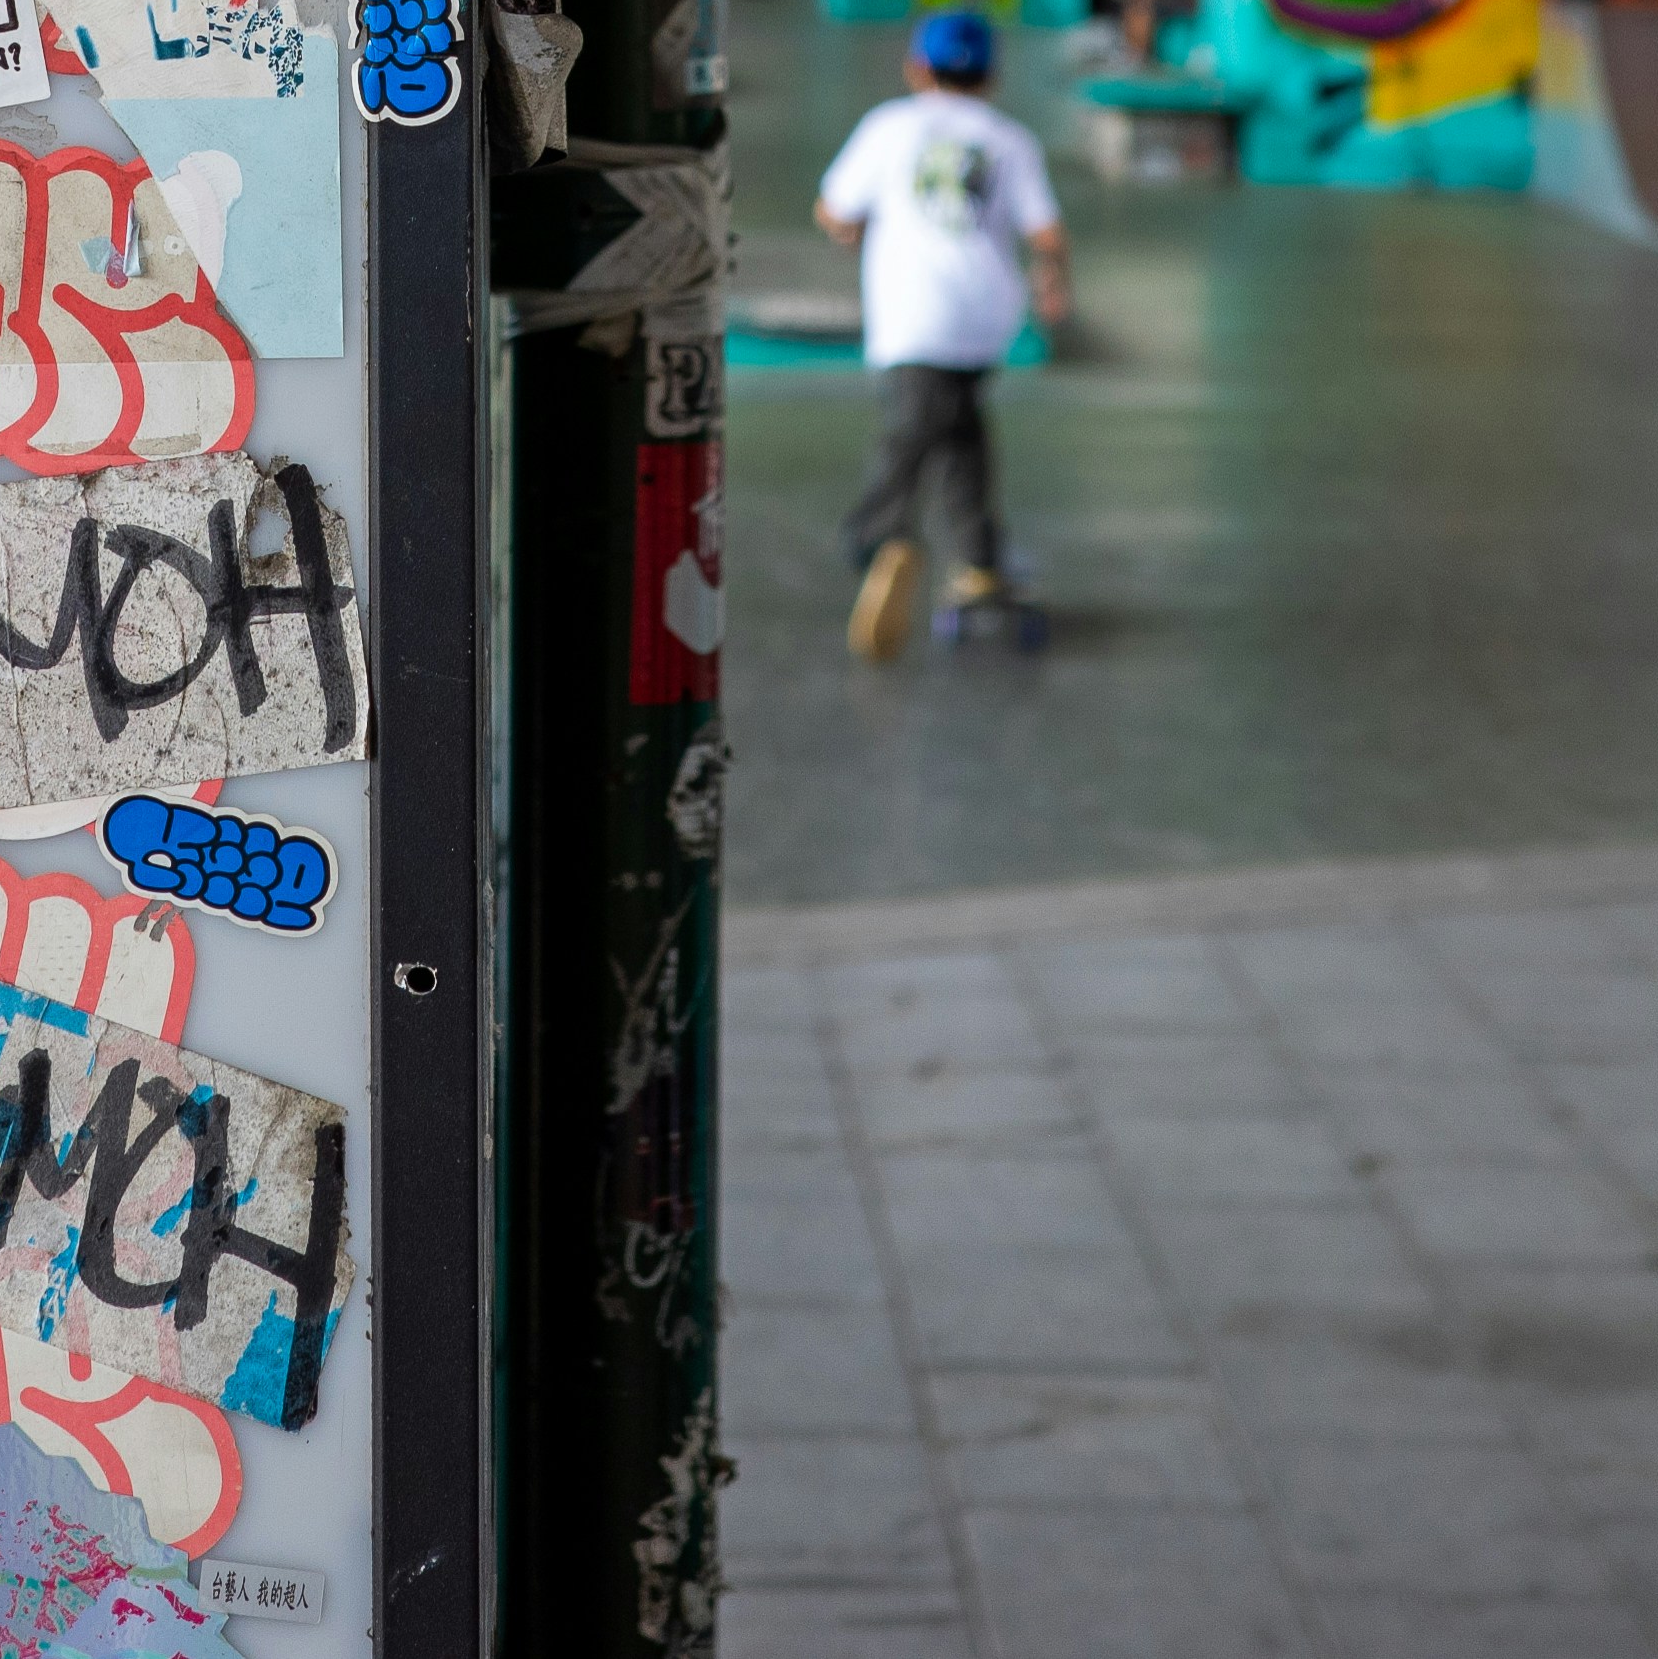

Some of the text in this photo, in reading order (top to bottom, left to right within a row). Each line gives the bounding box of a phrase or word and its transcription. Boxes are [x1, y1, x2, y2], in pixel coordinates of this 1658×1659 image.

[211, 1570, 310, 1610] 台藝人 我的超人
